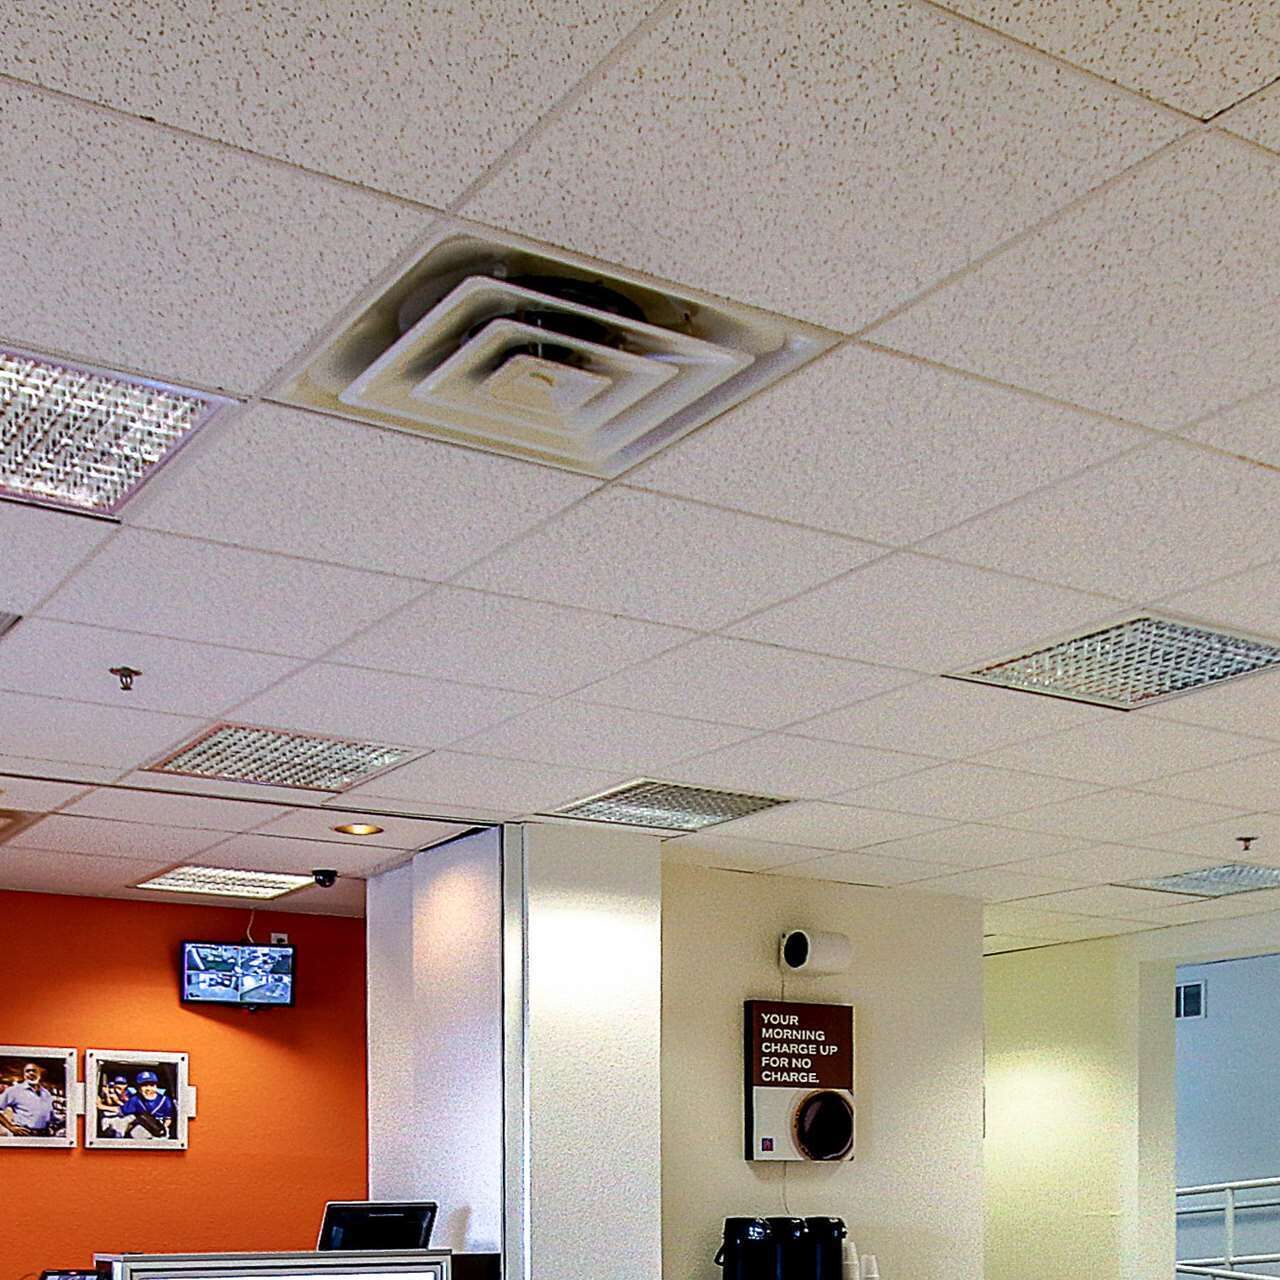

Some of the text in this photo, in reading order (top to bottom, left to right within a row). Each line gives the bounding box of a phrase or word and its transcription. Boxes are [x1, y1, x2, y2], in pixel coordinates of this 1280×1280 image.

[761, 1013, 799, 1025] YOUR
[761, 1028, 825, 1041] MORNING
[761, 1042, 839, 1056] CHARGE UP
[761, 1056, 812, 1069] FOR NO
[761, 1071, 820, 1083] CHARGE.
